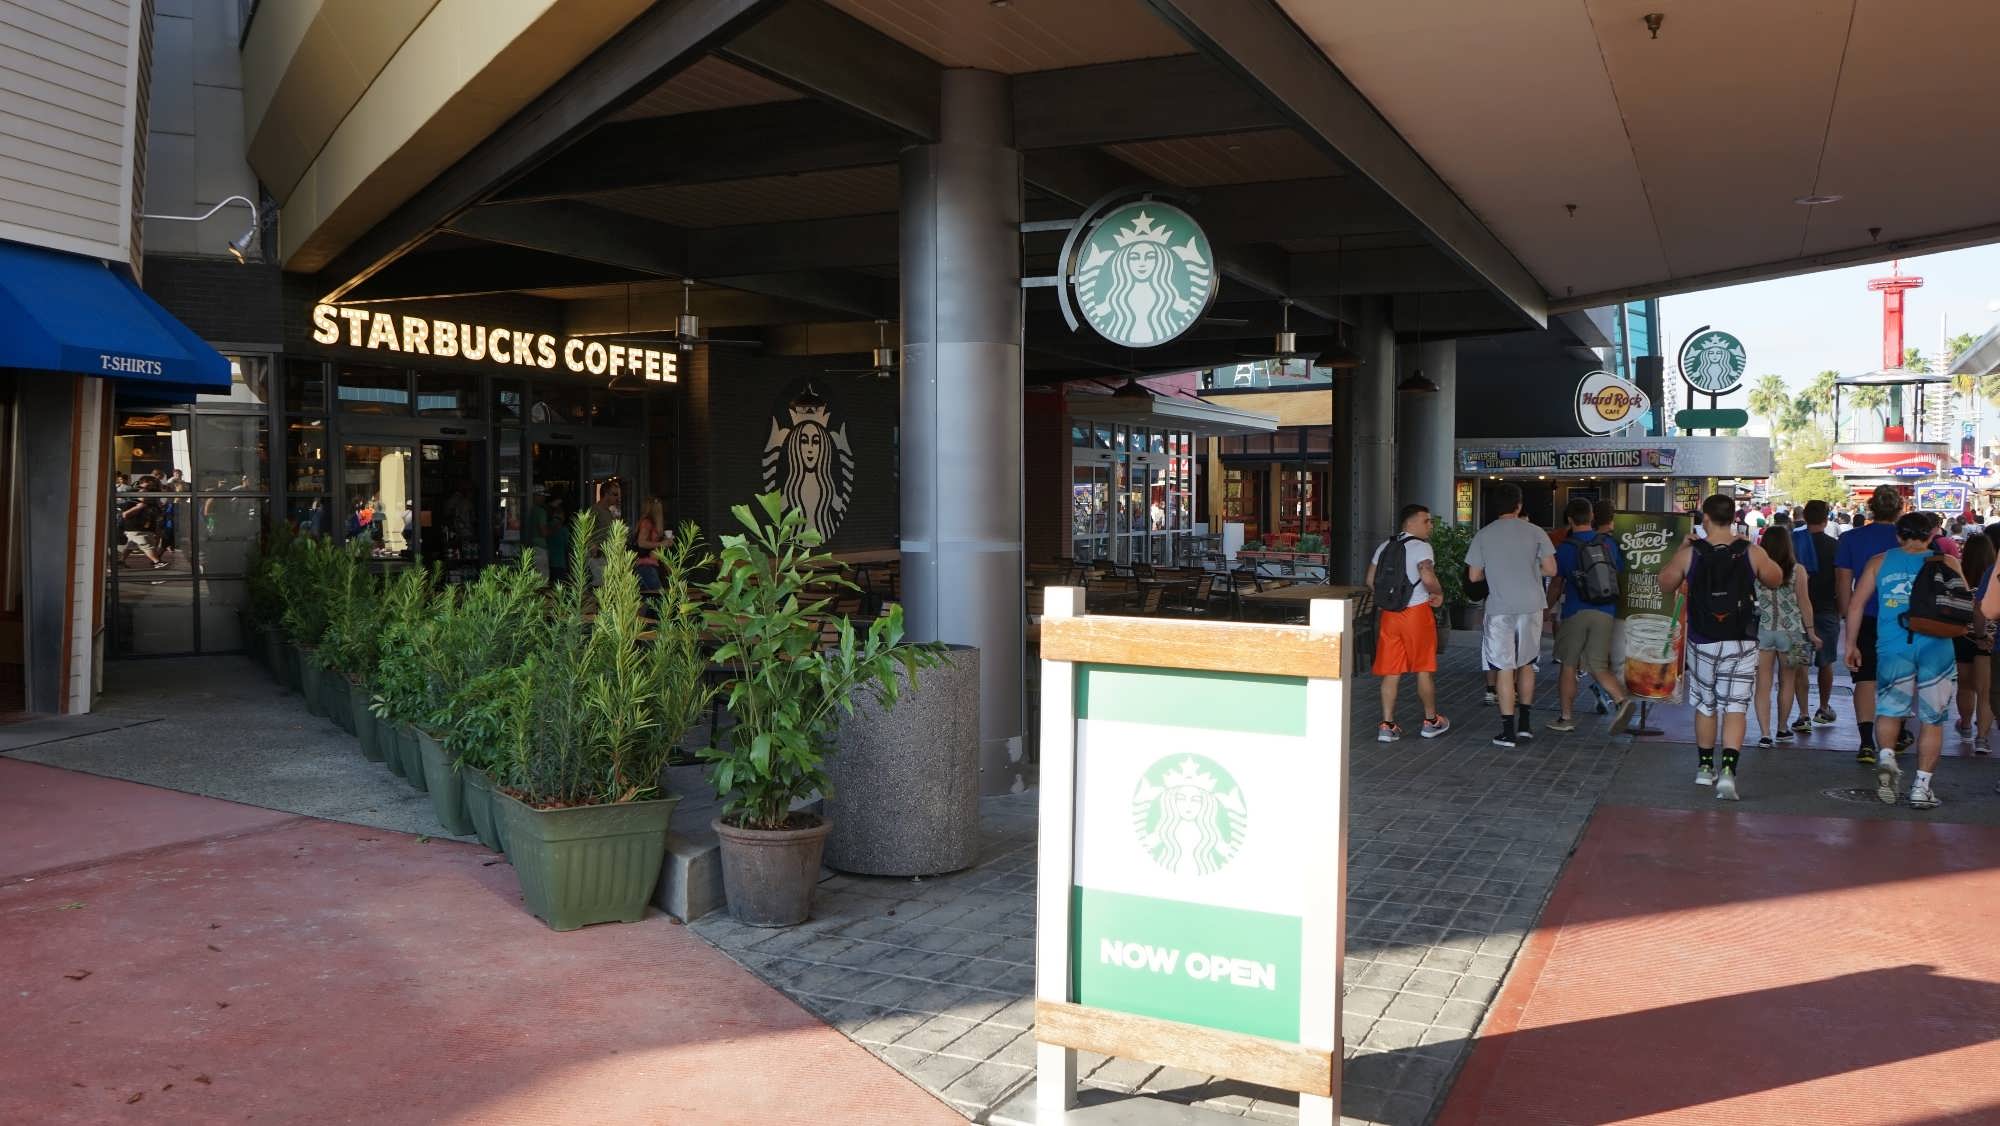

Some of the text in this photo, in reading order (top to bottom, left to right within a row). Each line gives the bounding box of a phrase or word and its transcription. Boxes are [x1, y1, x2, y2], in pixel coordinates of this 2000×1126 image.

[313, 303, 678, 383] STARBUCKS COFFEE
[100, 354, 162, 375] T-SHIRTS
[1583, 392, 1642, 408] Hard Rock
[1520, 451, 1555, 467] DINING
[1559, 451, 1640, 469] RESERVATIONS
[1620, 529, 1674, 550] Sweet
[1626, 547, 1666, 569] Tea
[1626, 598, 1662, 610] TRADITION
[1100, 938, 1277, 991] NOW OPEN
